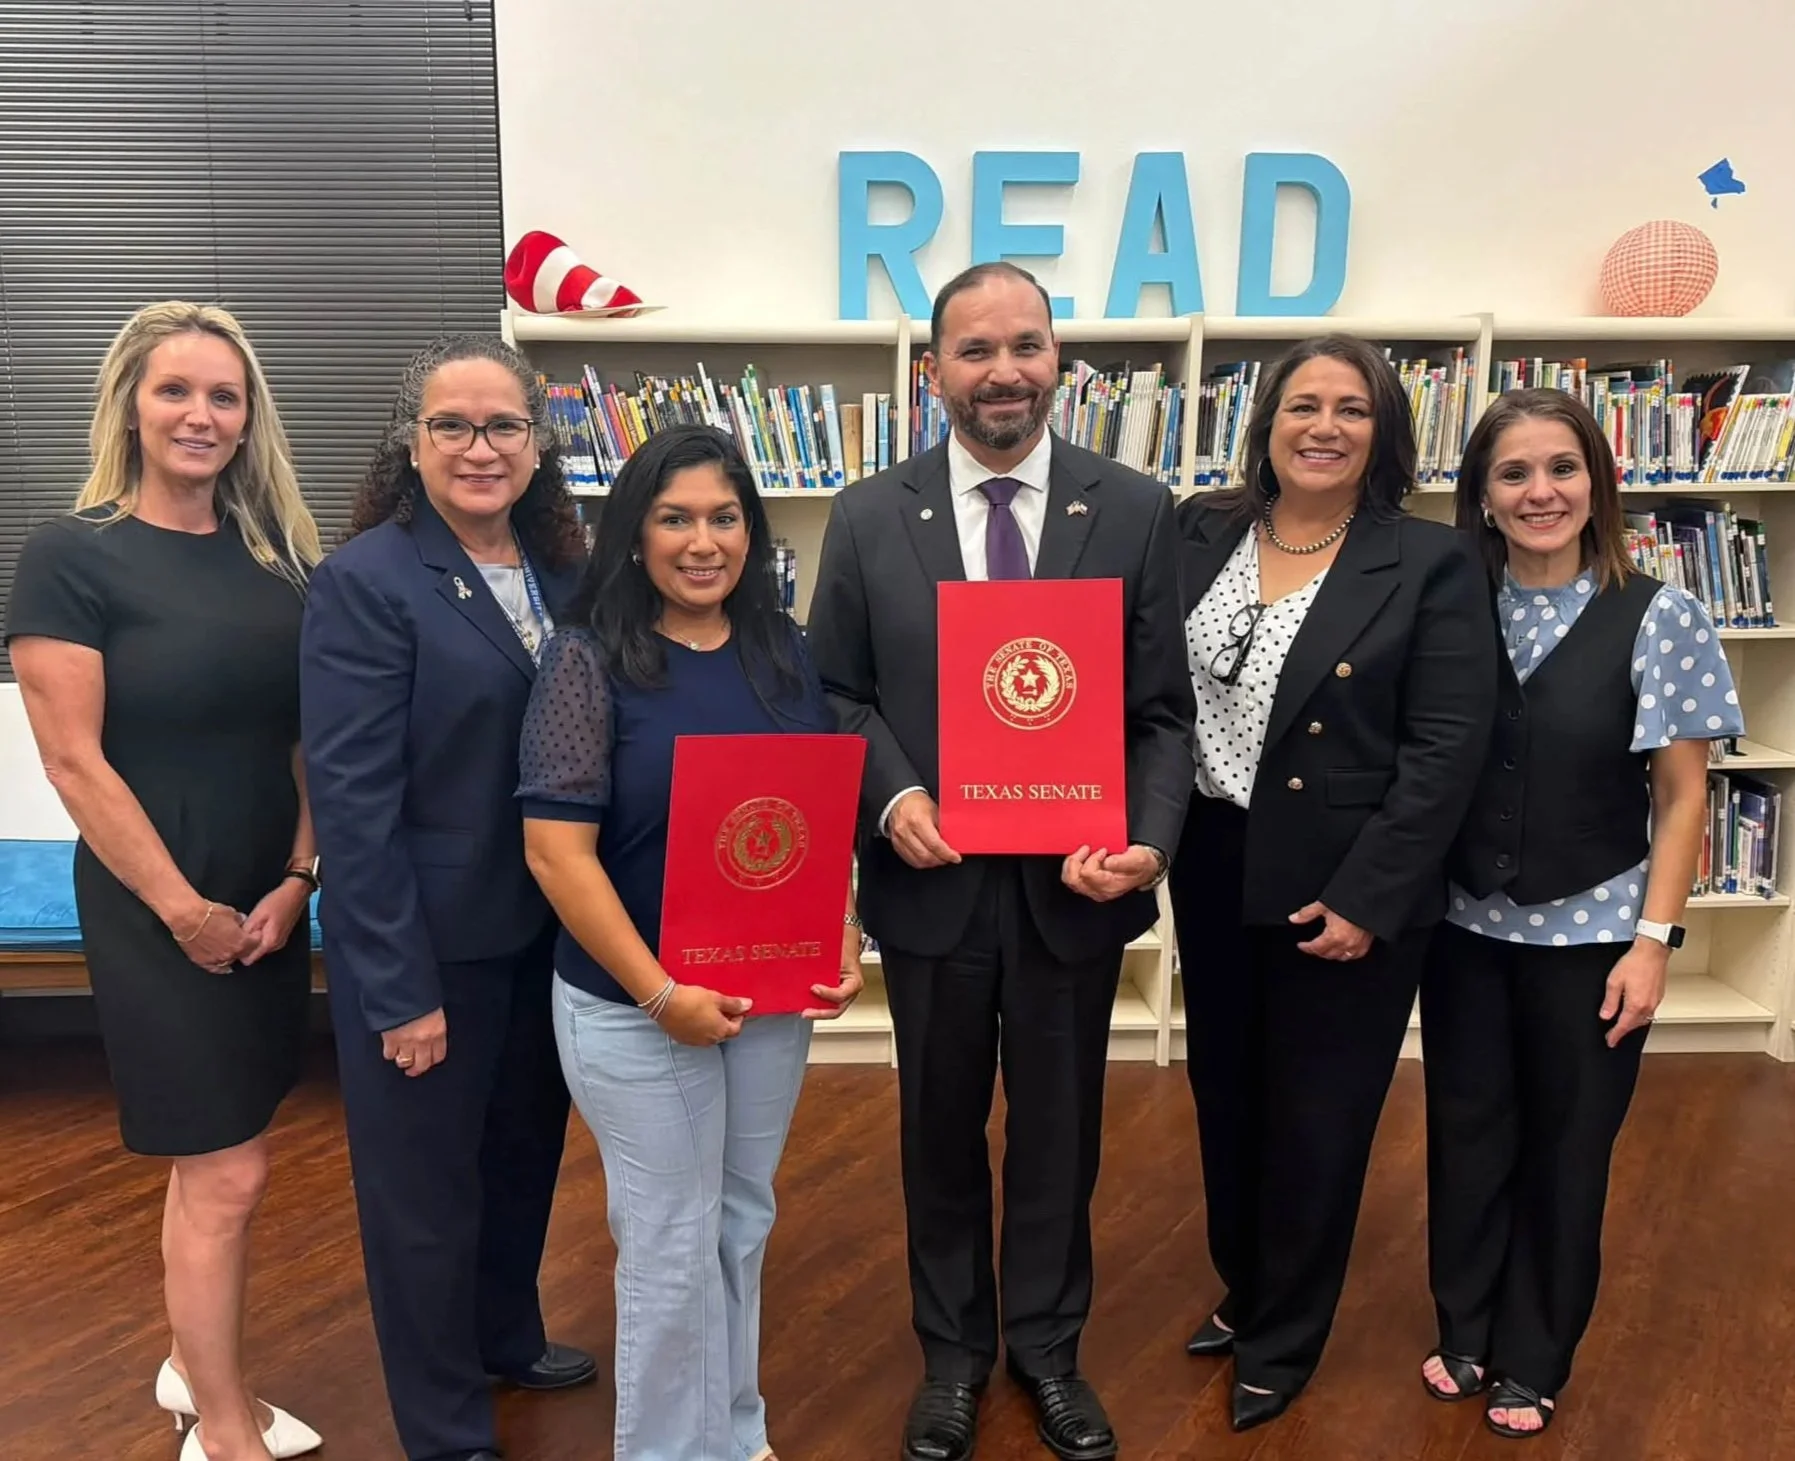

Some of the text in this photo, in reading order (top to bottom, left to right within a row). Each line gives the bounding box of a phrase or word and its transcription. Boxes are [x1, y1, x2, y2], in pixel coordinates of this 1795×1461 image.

[837, 150, 1351, 320] READ
[986, 641, 1074, 689] THE SENATE OF TEXAS
[960, 784, 1103, 800] TEXAS SENATE
[682, 941, 822, 965] TEXAS SENATE
